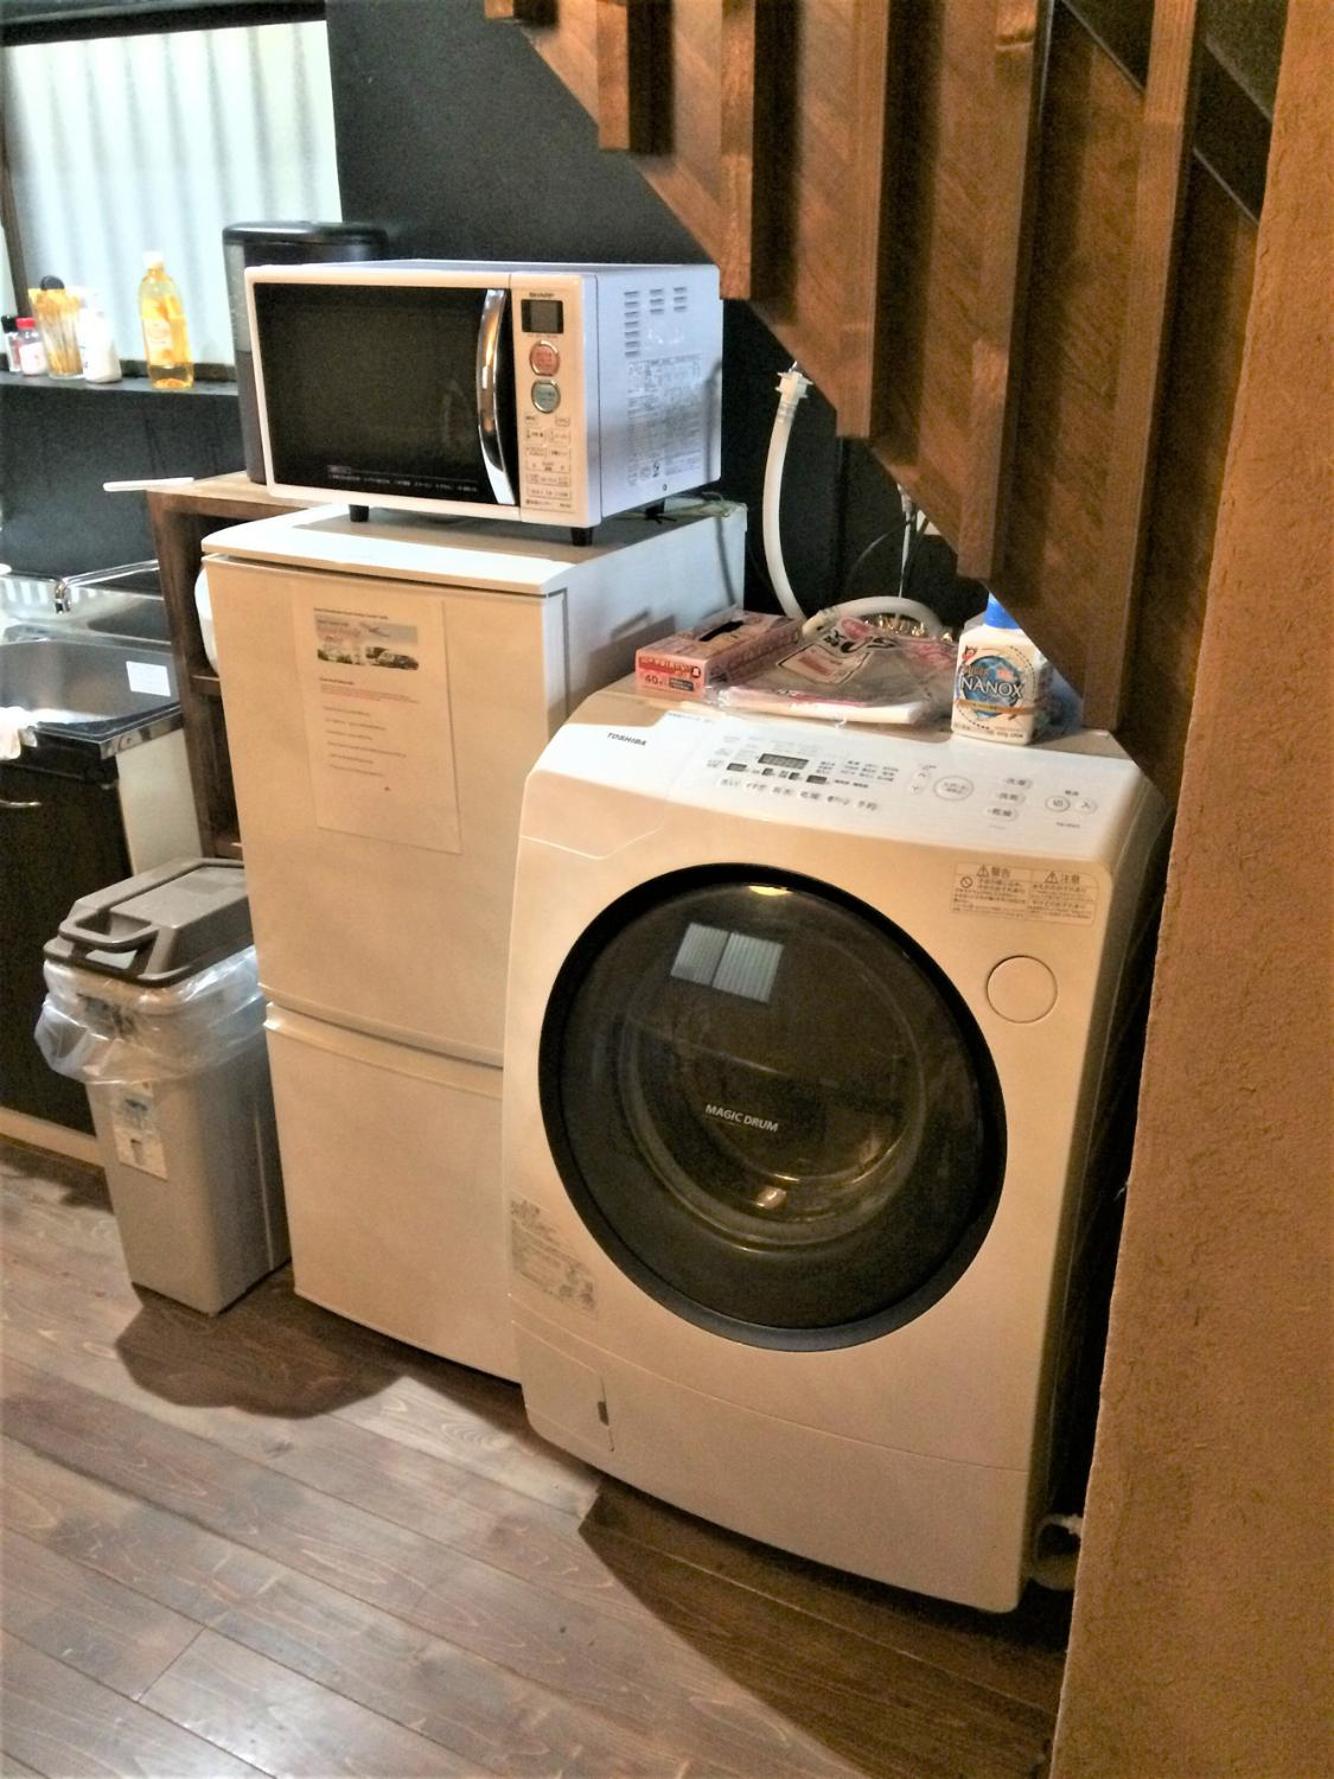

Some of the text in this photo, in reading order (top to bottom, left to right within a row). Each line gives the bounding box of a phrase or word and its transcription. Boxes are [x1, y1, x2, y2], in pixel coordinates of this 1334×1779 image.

[961, 676, 1024, 700] NANOX
[607, 732, 647, 746] TOSHIBA
[705, 1103, 779, 1133] MAGIC DRUM
